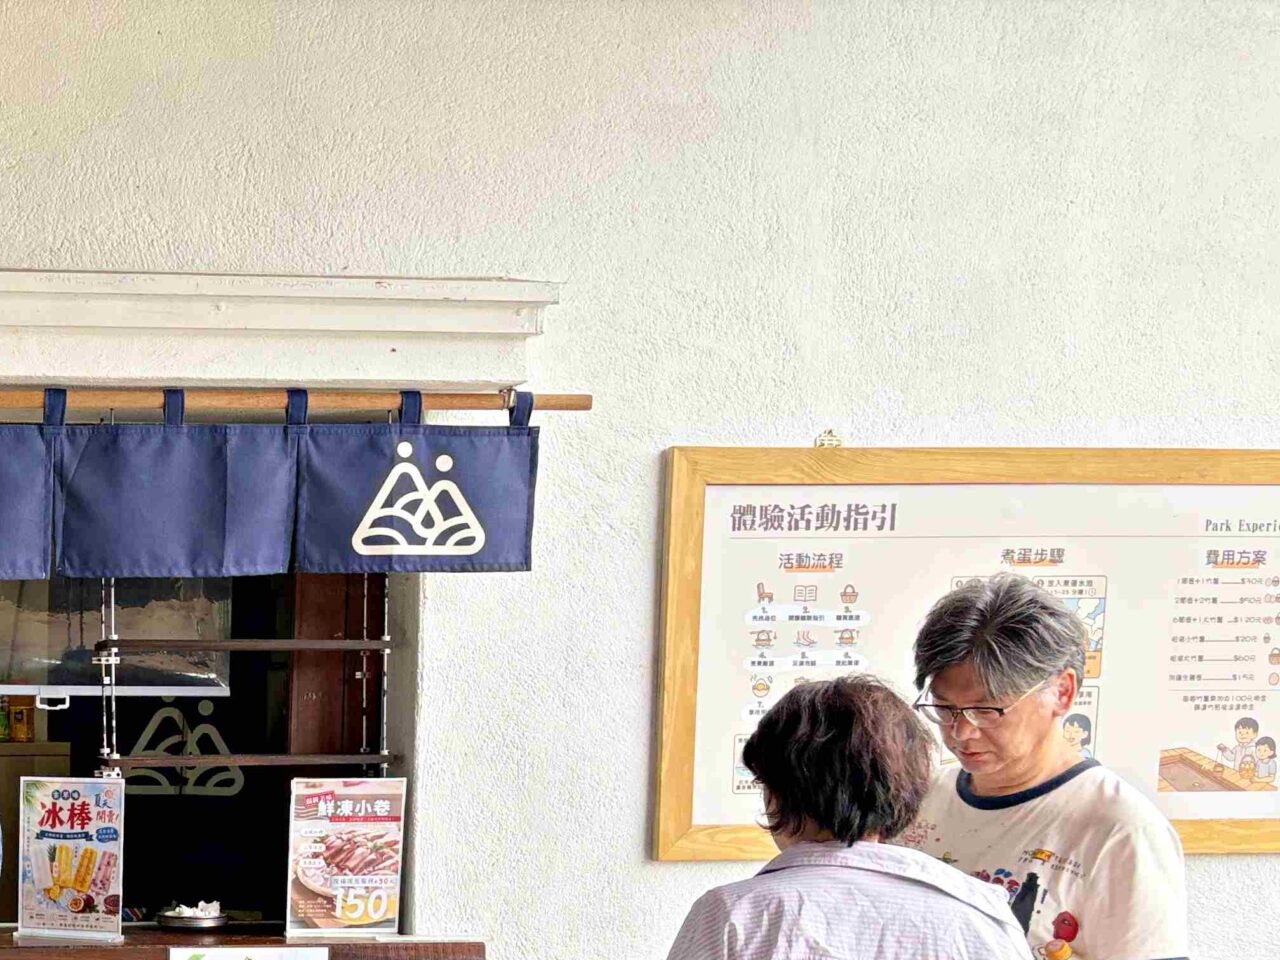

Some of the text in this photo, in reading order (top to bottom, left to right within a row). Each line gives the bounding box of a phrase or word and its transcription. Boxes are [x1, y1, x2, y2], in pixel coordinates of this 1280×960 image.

[730, 502, 898, 532] 體驗活動指引
[1205, 518, 1232, 532] Park
[778, 552, 844, 569] 活動流程
[1000, 548, 1066, 565] 煮蛋步驟
[1205, 549, 1267, 566] 費用方案
[38, 801, 93, 830] 冰棒
[317, 799, 392, 817] 鮮凍小卷
[334, 888, 389, 920] 150
